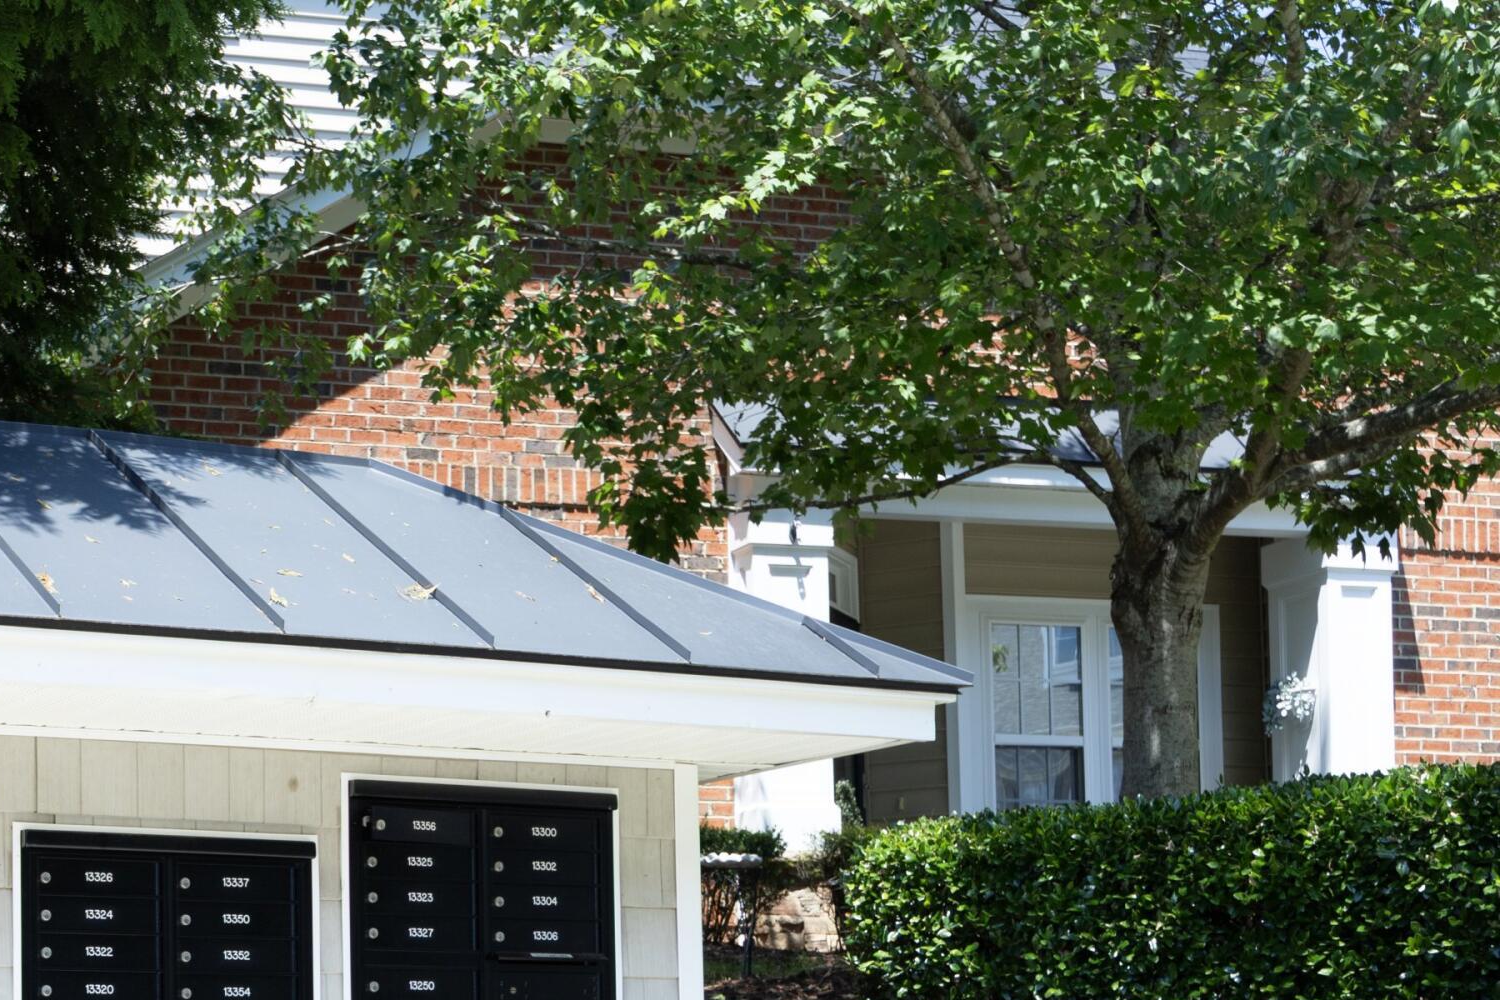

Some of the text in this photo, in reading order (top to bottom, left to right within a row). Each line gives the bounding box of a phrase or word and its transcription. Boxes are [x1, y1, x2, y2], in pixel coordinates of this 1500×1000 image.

[412, 820, 437, 832] 13356
[531, 826, 558, 838] 13300
[407, 856, 434, 868] 13325
[531, 860, 557, 872] 13302
[84, 871, 114, 883] 13326
[222, 876, 250, 888] 13337
[407, 891, 434, 903] 13323
[532, 895, 558, 906] 13304
[84, 908, 114, 920] 13324
[222, 913, 251, 925] 13350
[407, 927, 435, 938] 13327
[532, 930, 559, 941] 13306
[85, 946, 114, 958] 13322
[222, 949, 251, 961] 13352
[85, 983, 115, 995] 13320
[408, 980, 436, 991] 13250
[223, 986, 251, 998] 13354
